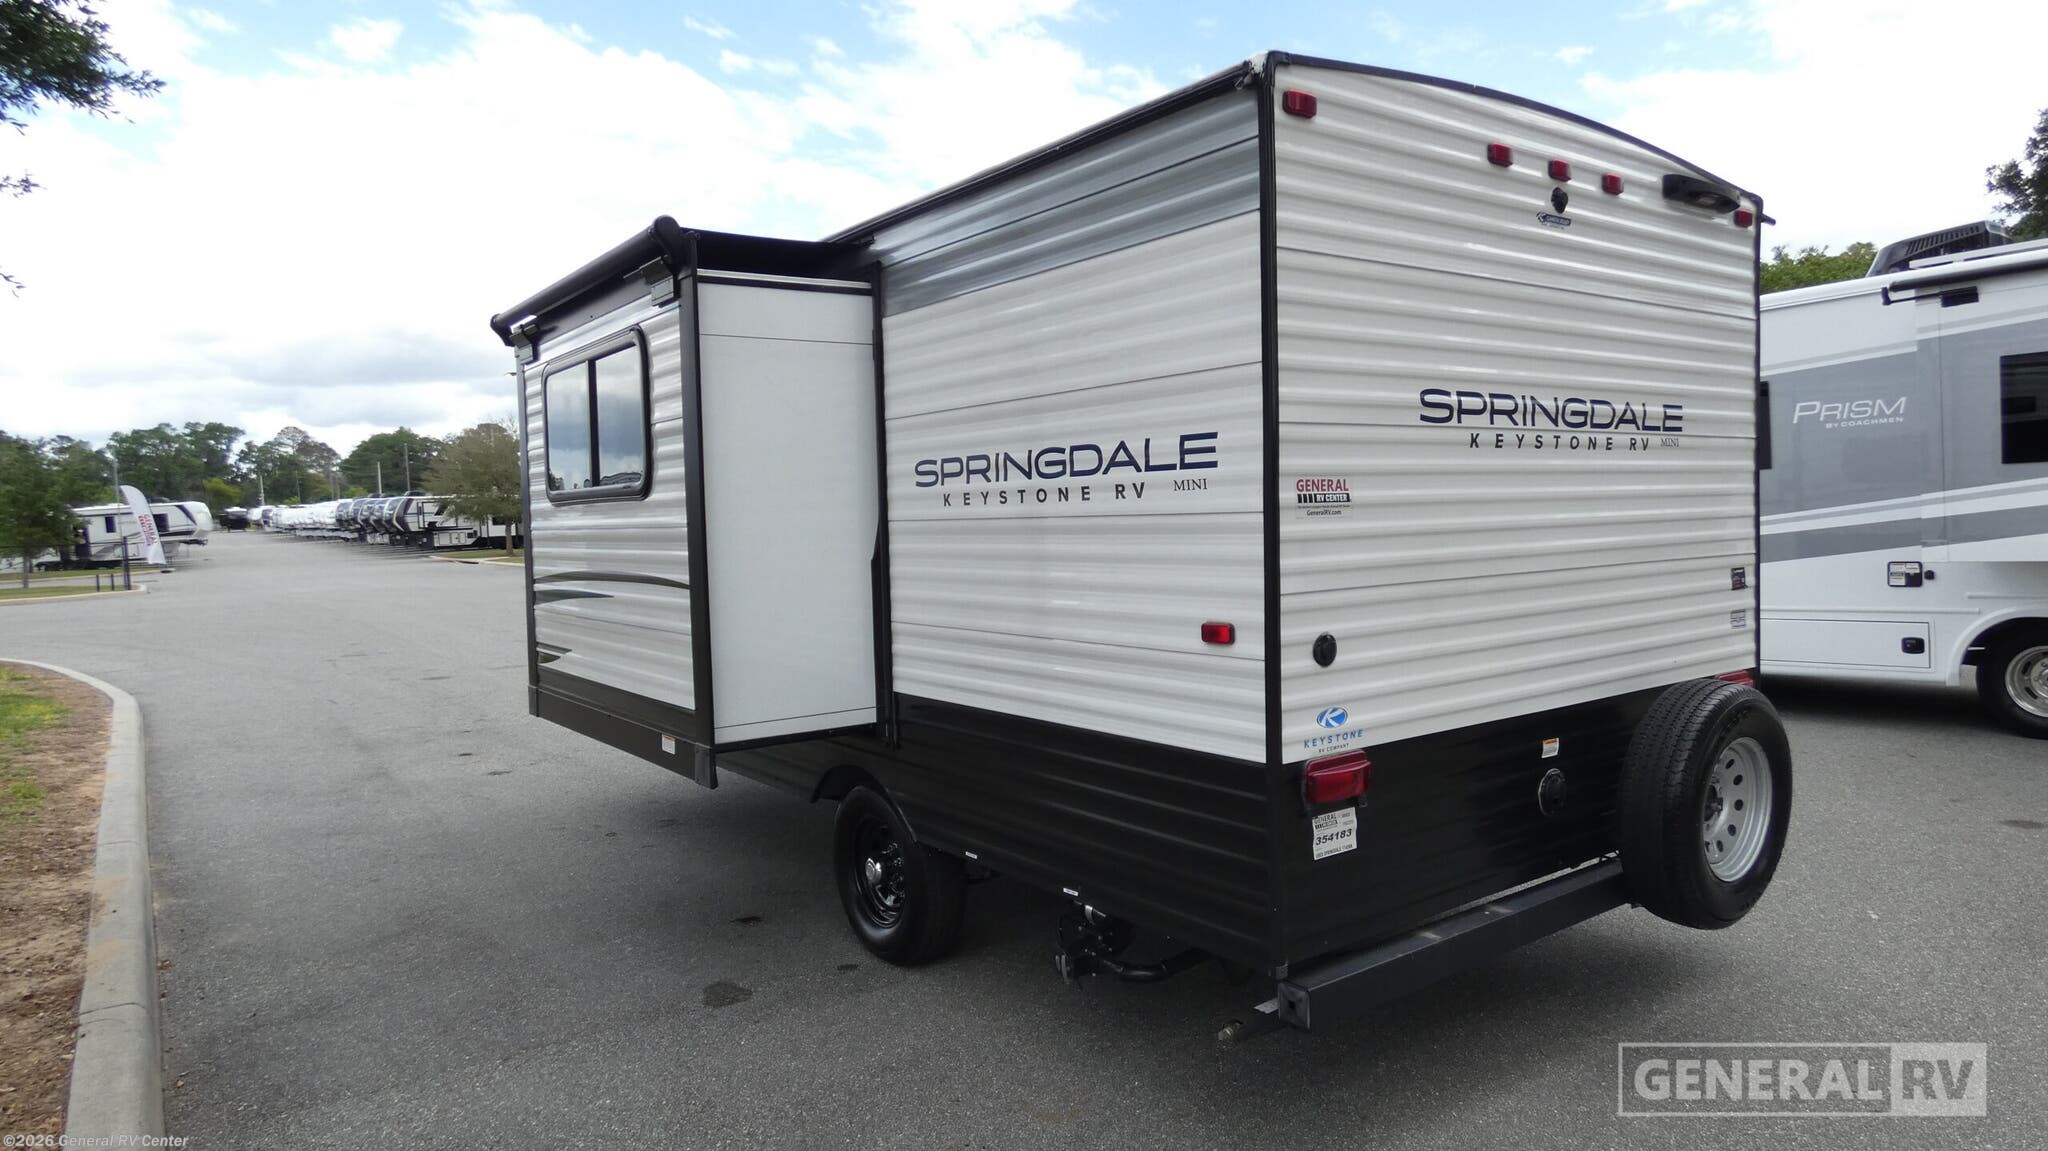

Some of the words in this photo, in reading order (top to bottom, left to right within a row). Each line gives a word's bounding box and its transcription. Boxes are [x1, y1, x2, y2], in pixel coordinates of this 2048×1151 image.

[1420, 388, 1683, 433] SPRINGDALE
[1792, 396, 1907, 424] PRISM
[1840, 416, 1904, 428] COACHMEN
[1470, 433, 1613, 450] KEYSTONE
[1629, 437, 1649, 451] RV
[1660, 437, 1679, 448] MINI
[914, 431, 1218, 488] SPRINGDALE
[943, 485, 1091, 507] KEYSTONE
[1115, 481, 1146, 500] RV
[1173, 478, 1208, 492] MINI
[1296, 479, 1349, 492] GENERAL
[1325, 494, 1348, 502] CENTER
[1303, 729, 1364, 749] KEYSTONE
[1315, 828, 1353, 846] 354183
